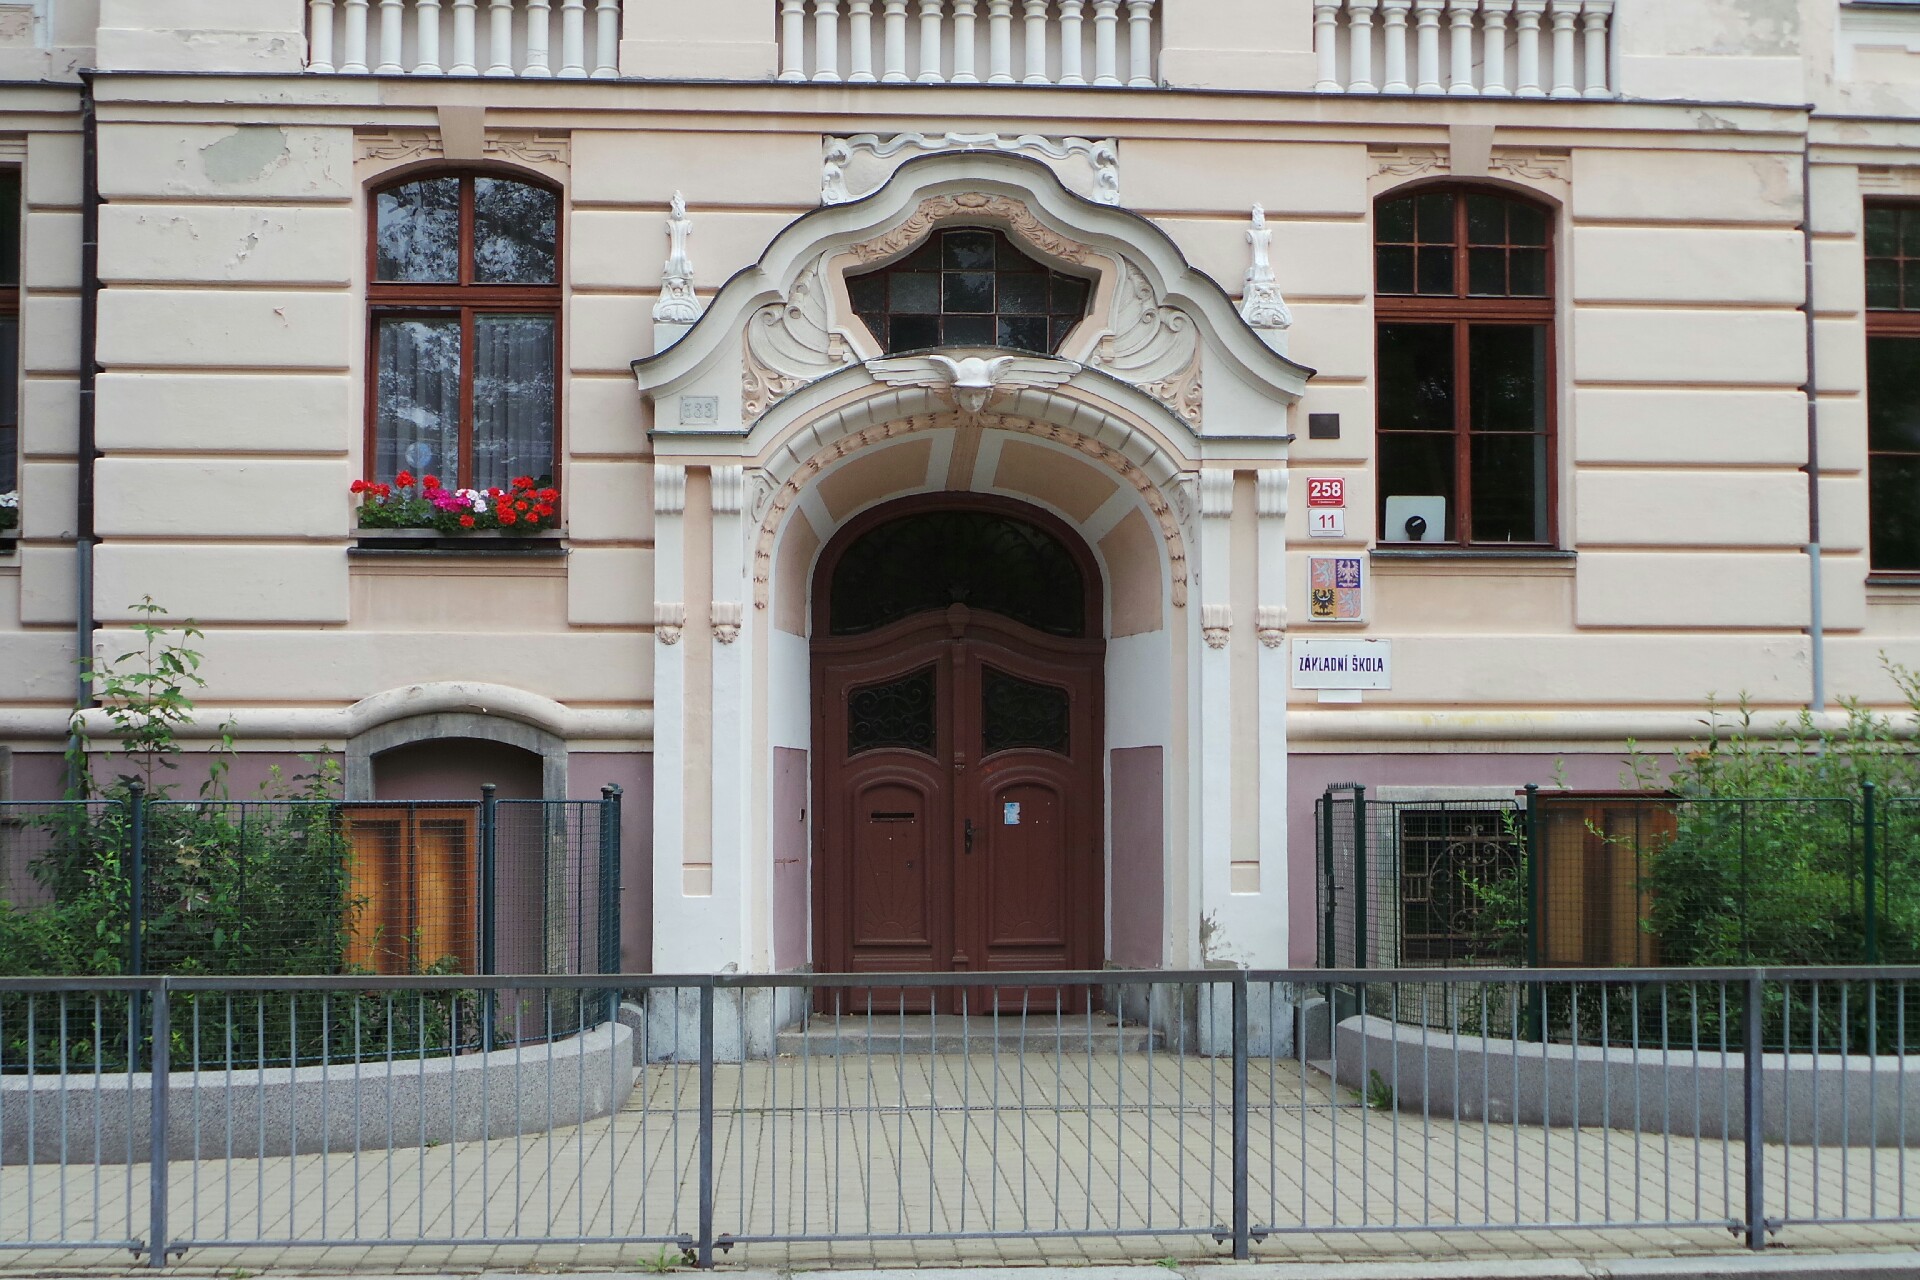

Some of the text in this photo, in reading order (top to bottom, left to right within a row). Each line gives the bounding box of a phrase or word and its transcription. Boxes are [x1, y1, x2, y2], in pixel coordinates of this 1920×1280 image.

[1311, 482, 1341, 497] 258
[1319, 514, 1335, 528] 11
[1299, 653, 1384, 672] ZÁKLADNÍ ŠKOLA
